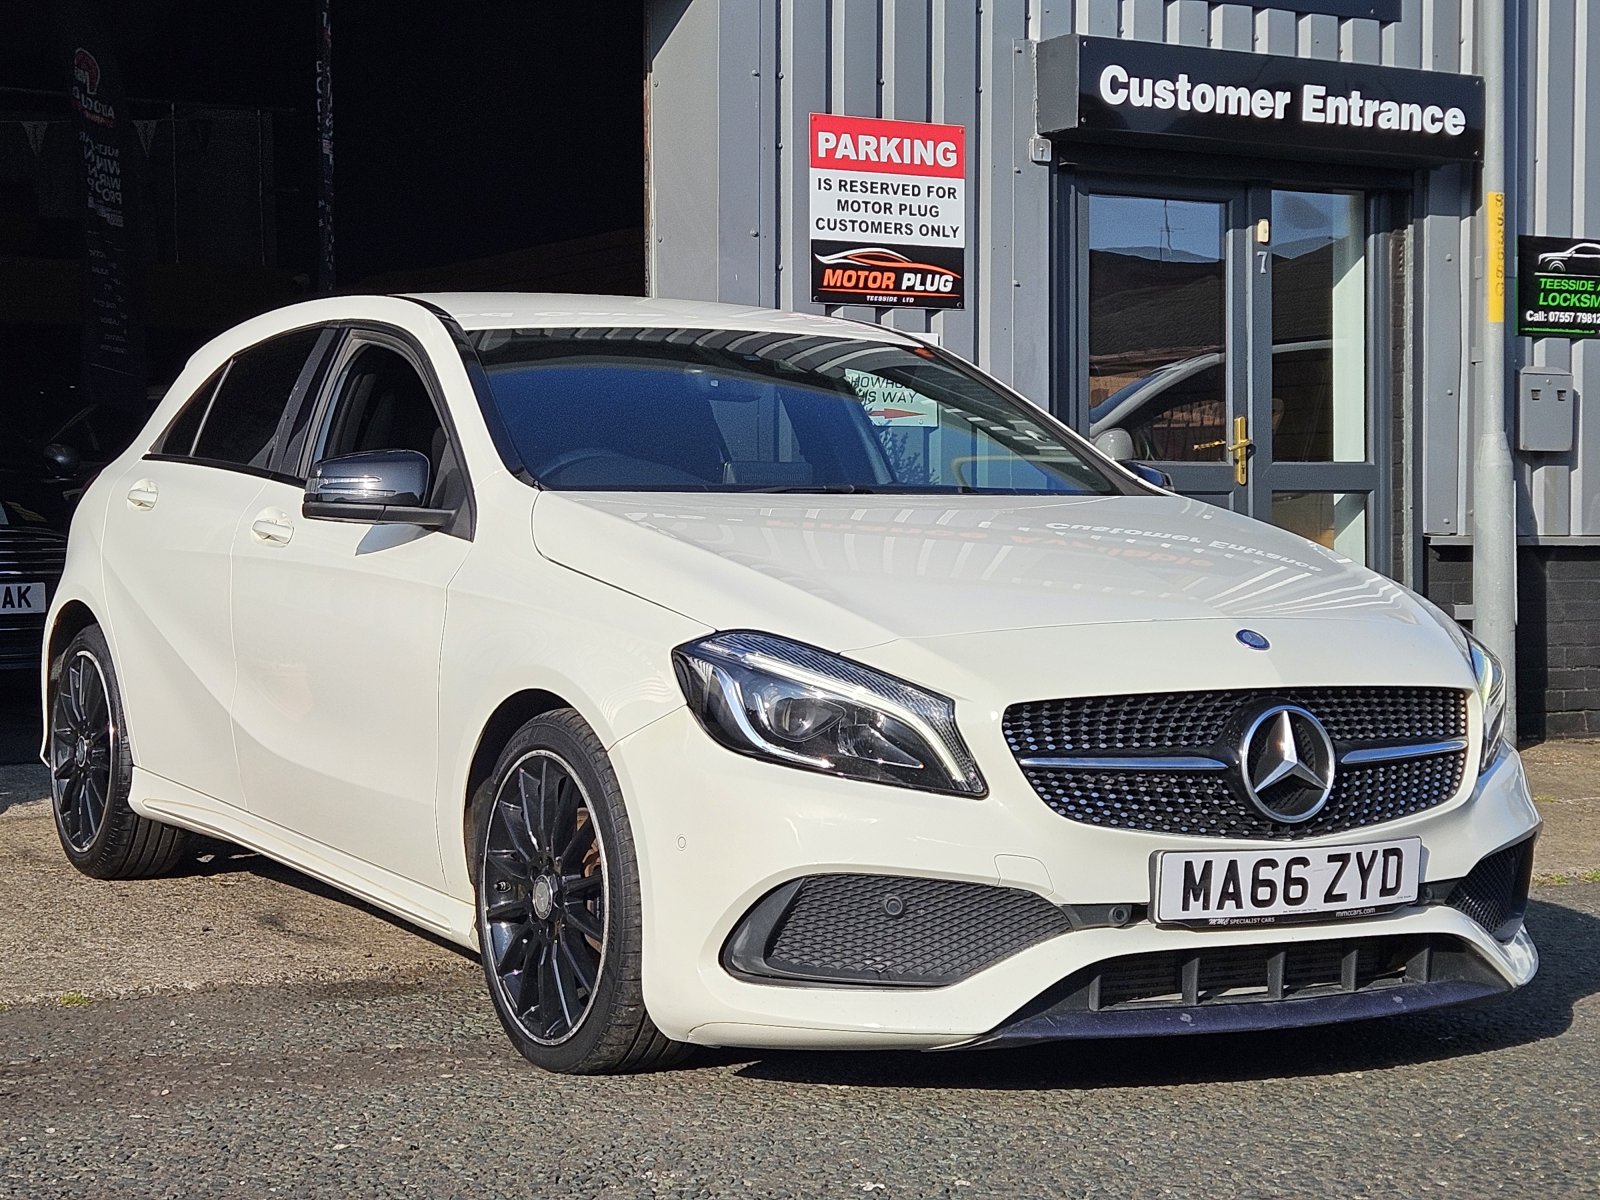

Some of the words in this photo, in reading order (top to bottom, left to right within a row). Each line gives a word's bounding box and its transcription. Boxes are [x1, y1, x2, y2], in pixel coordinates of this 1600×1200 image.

[1100, 64, 1291, 119] Customer
[1302, 84, 1466, 136] Entrance
[817, 131, 957, 167] PARKING
[818, 178, 832, 190] IS
[838, 179, 921, 197] RESERVED
[927, 186, 957, 199] FOR
[837, 199, 893, 215] MOTOR
[899, 203, 939, 218] PLUG
[816, 217, 913, 236] CUSTOMERS
[919, 224, 960, 239] ONLY
[1257, 250, 1268, 274] 7
[823, 268, 895, 289] MOTOR
[902, 272, 953, 293] PLUG
[1540, 278, 1596, 291] TEESSIDE
[866, 295, 898, 303] TEESSIDE
[1526, 310, 1547, 322] Call:
[1549, 311, 1575, 323] 07557
[882, 391, 918, 403] WAY
[2, 586, 31, 608] AK
[1182, 856, 1311, 912] MA66
[1323, 847, 1403, 904] ZYD
[1230, 917, 1260, 925] SPECIALIST
[1335, 907, 1375, 917] mmccars.com
